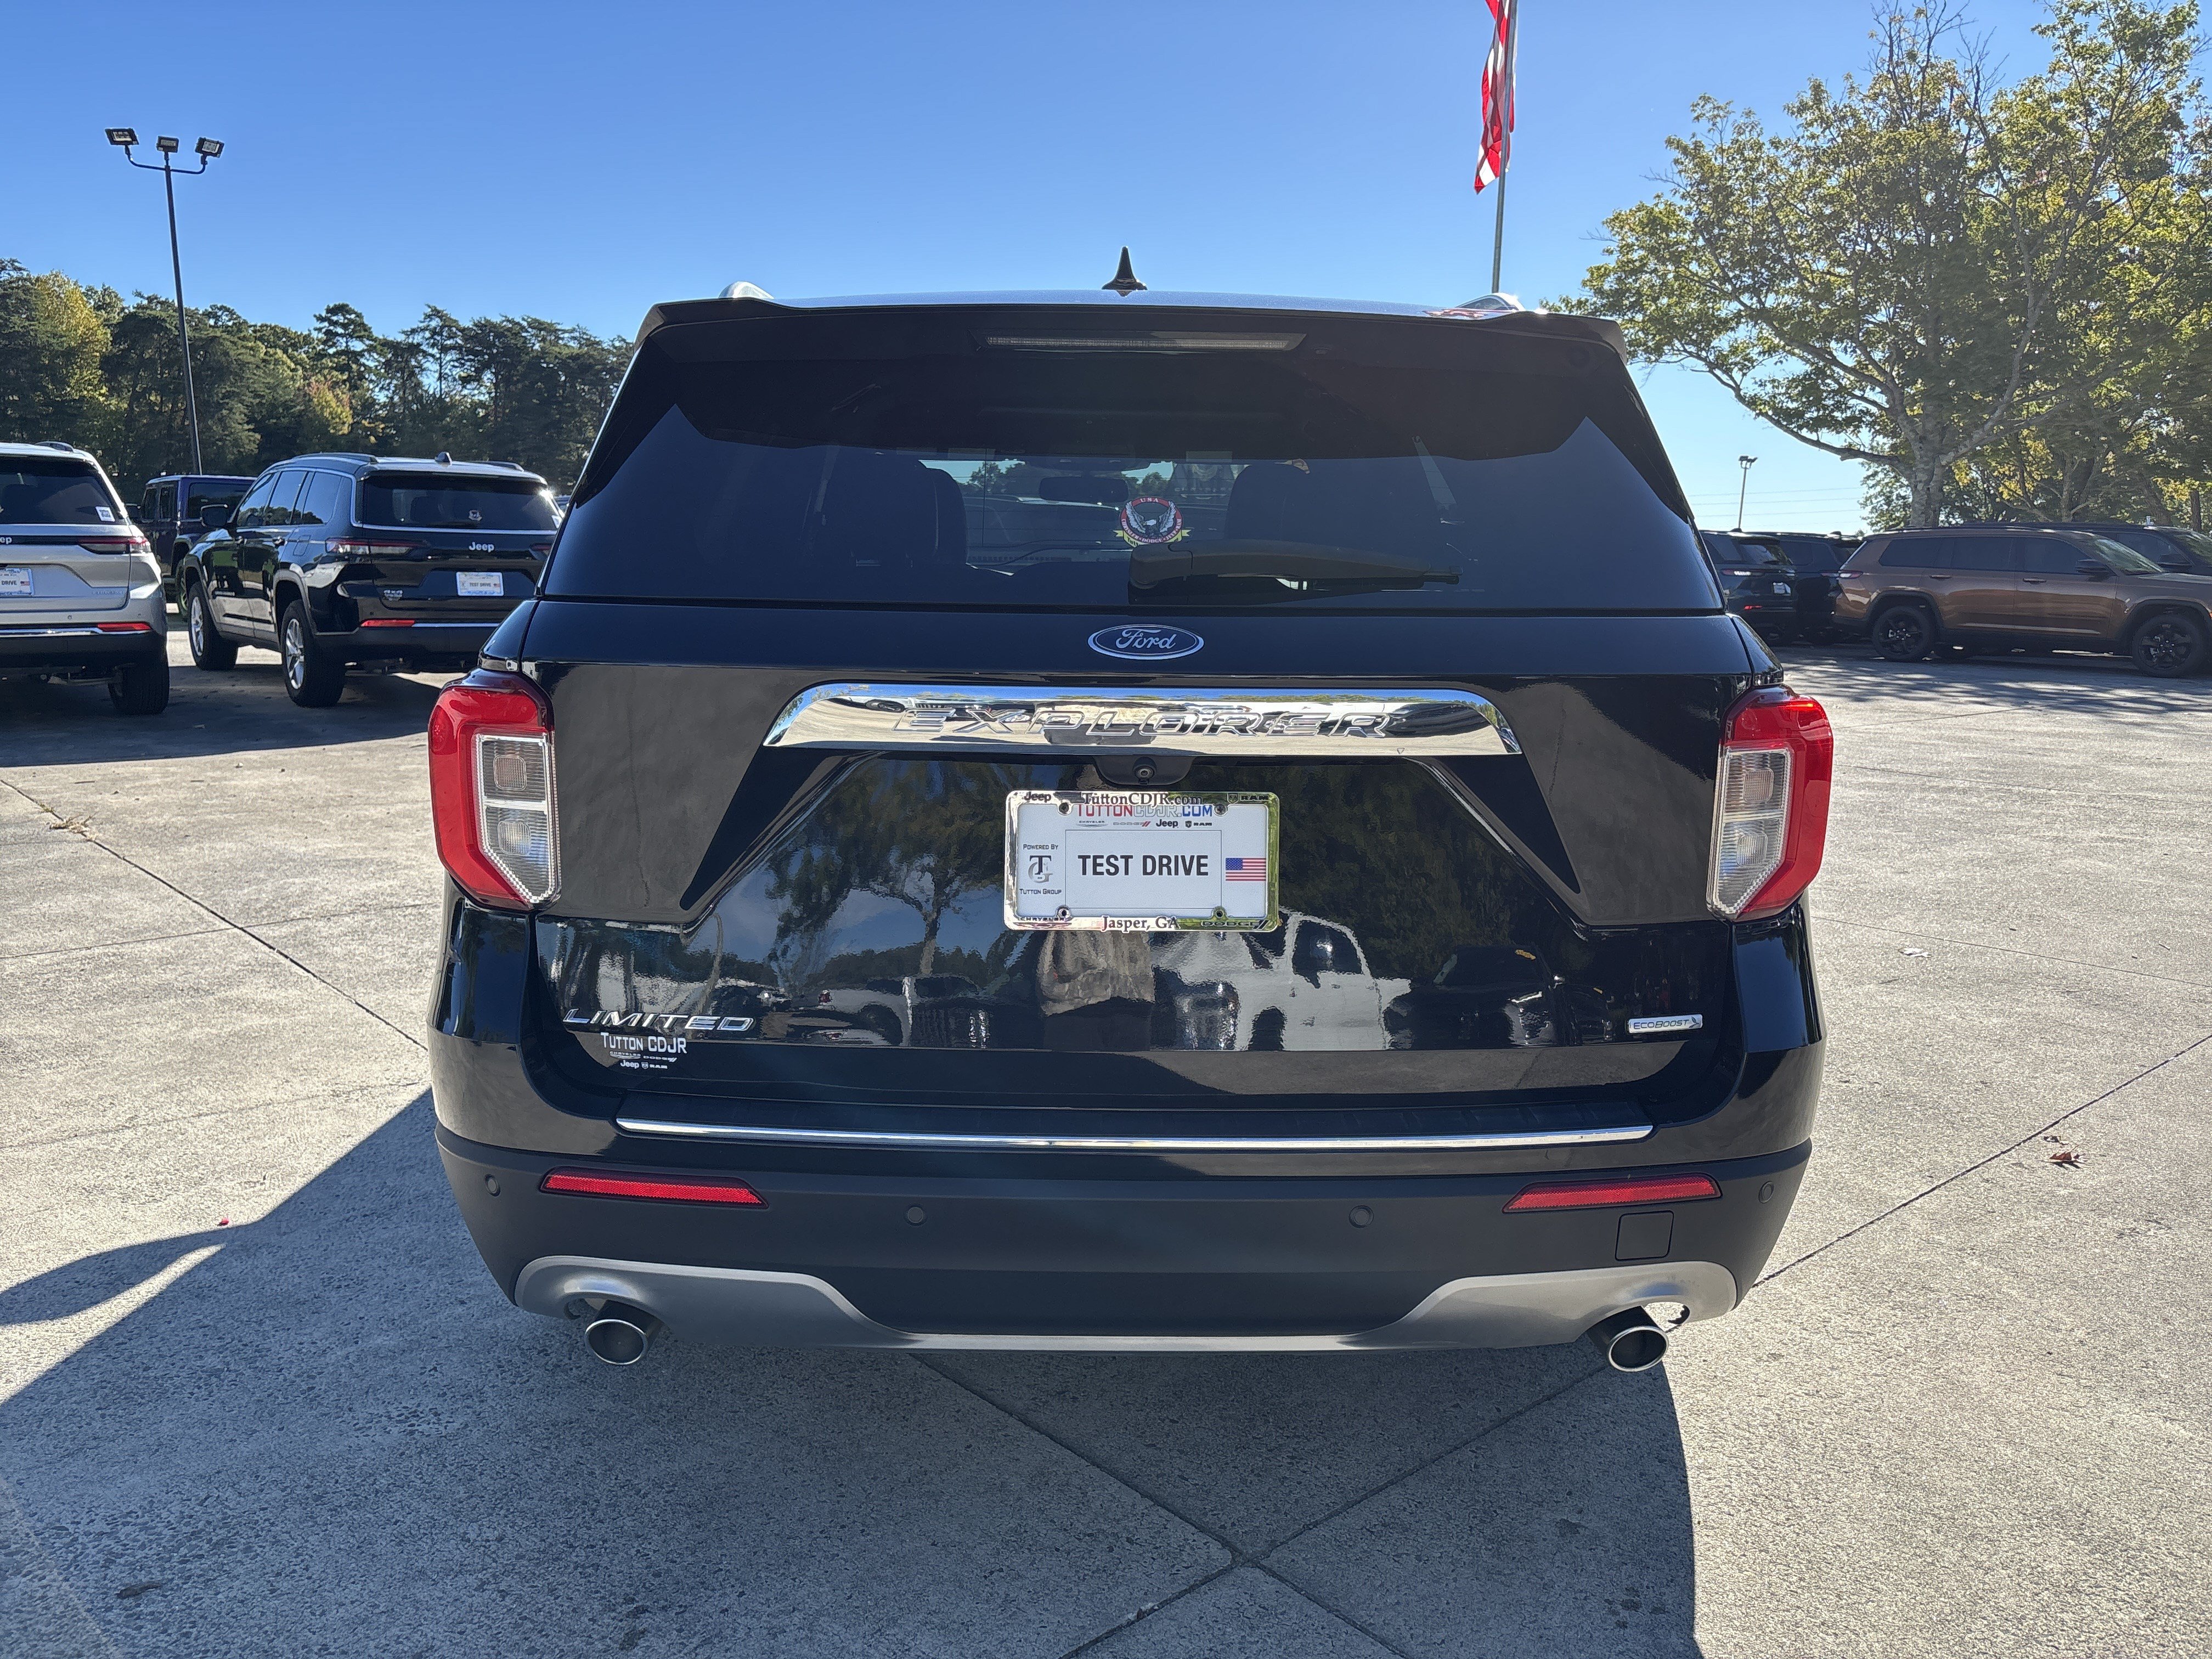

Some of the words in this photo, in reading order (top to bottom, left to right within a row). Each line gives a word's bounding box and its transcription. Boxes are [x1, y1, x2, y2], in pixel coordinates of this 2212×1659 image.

[469, 541, 494, 552] Jeep
[1115, 628, 1177, 649] Ford
[891, 708, 1391, 737] EXPLORER
[1024, 792, 1052, 803] Jeep
[1081, 792, 1203, 808] TuttonCDJR.com
[1156, 819, 1178, 828] Jeep
[1078, 855, 1133, 876] TEST
[1142, 854, 1209, 876] DRIVE
[1102, 916, 1150, 932] Jasper,
[1156, 916, 1181, 929] GA
[562, 1008, 757, 1032] LIMITED
[1633, 1019, 1690, 1030] ECOBOOST
[600, 1032, 644, 1051] TUTTON
[648, 1036, 687, 1054] CDJR
[620, 1060, 640, 1069] Jeep
